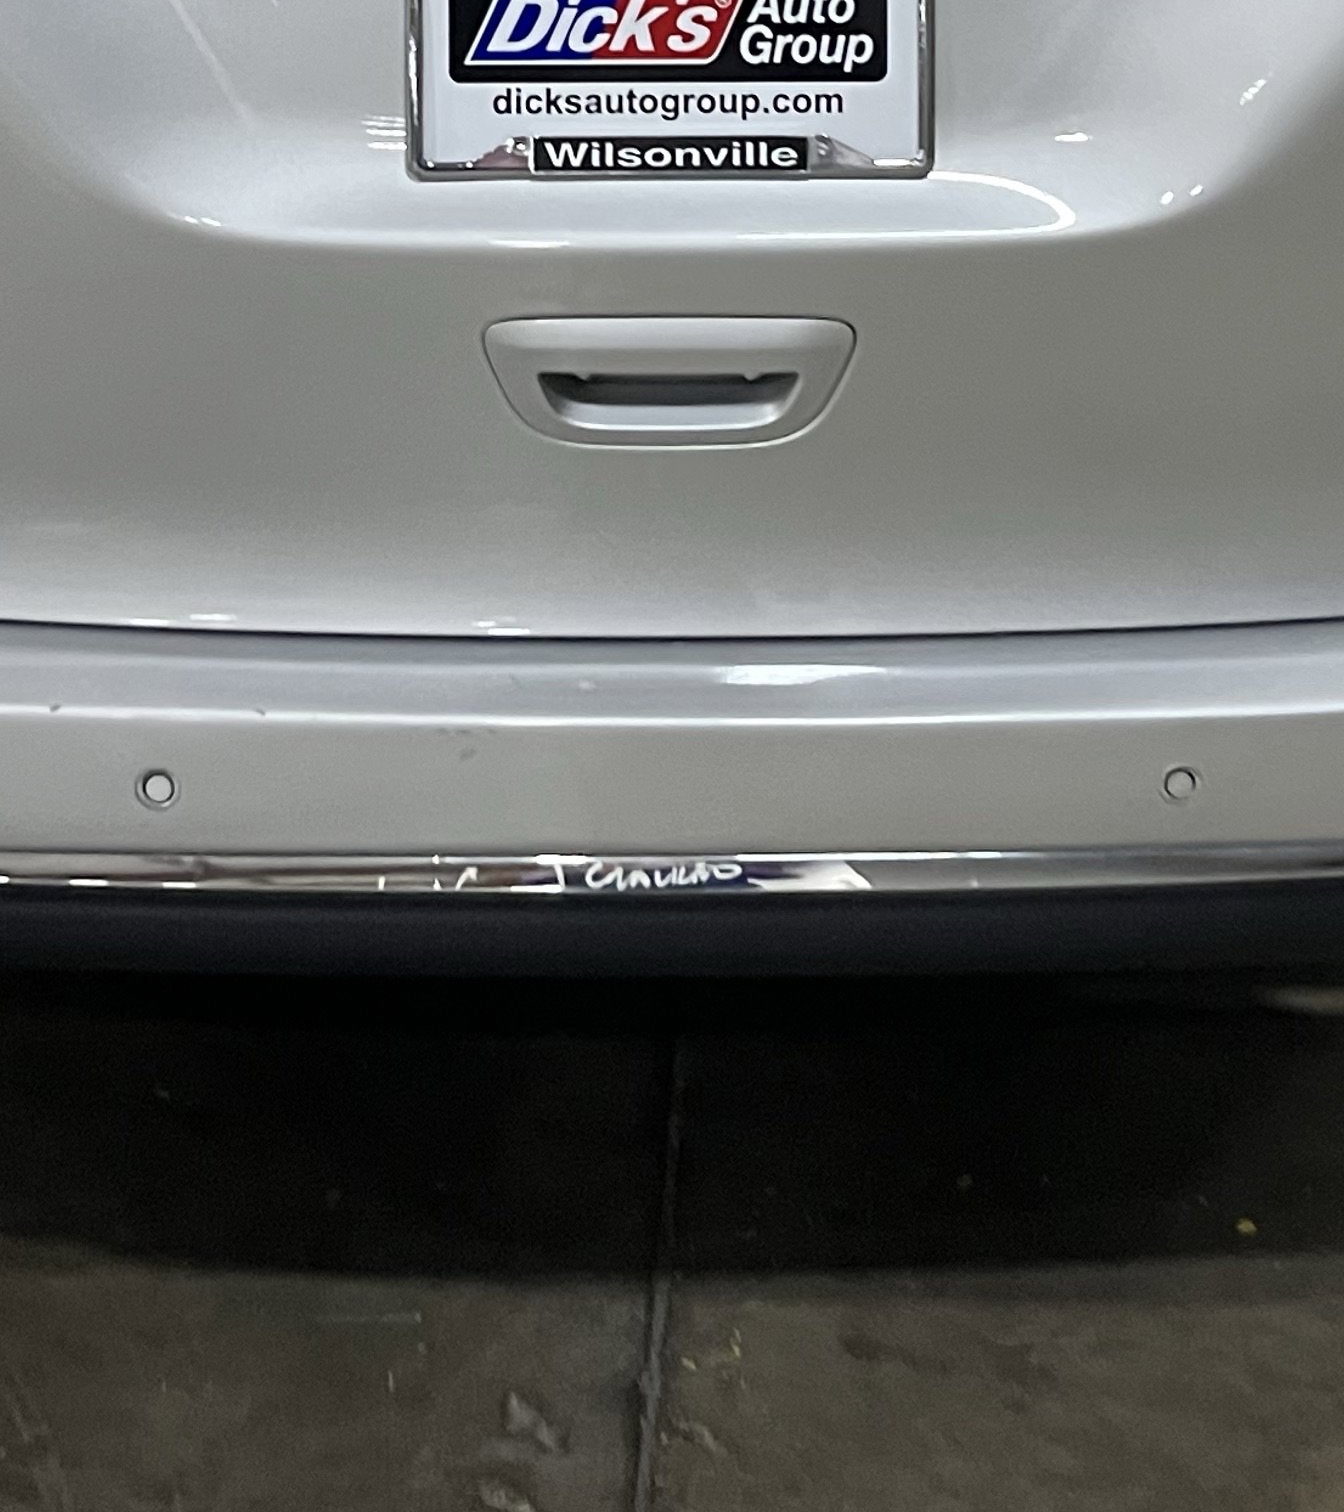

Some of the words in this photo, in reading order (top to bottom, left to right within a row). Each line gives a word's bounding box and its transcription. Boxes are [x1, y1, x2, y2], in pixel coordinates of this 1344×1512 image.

[739, 26, 874, 72] Group
[492, 88, 844, 120] dicksautogroup.com
[544, 141, 798, 168] Wilsonville
